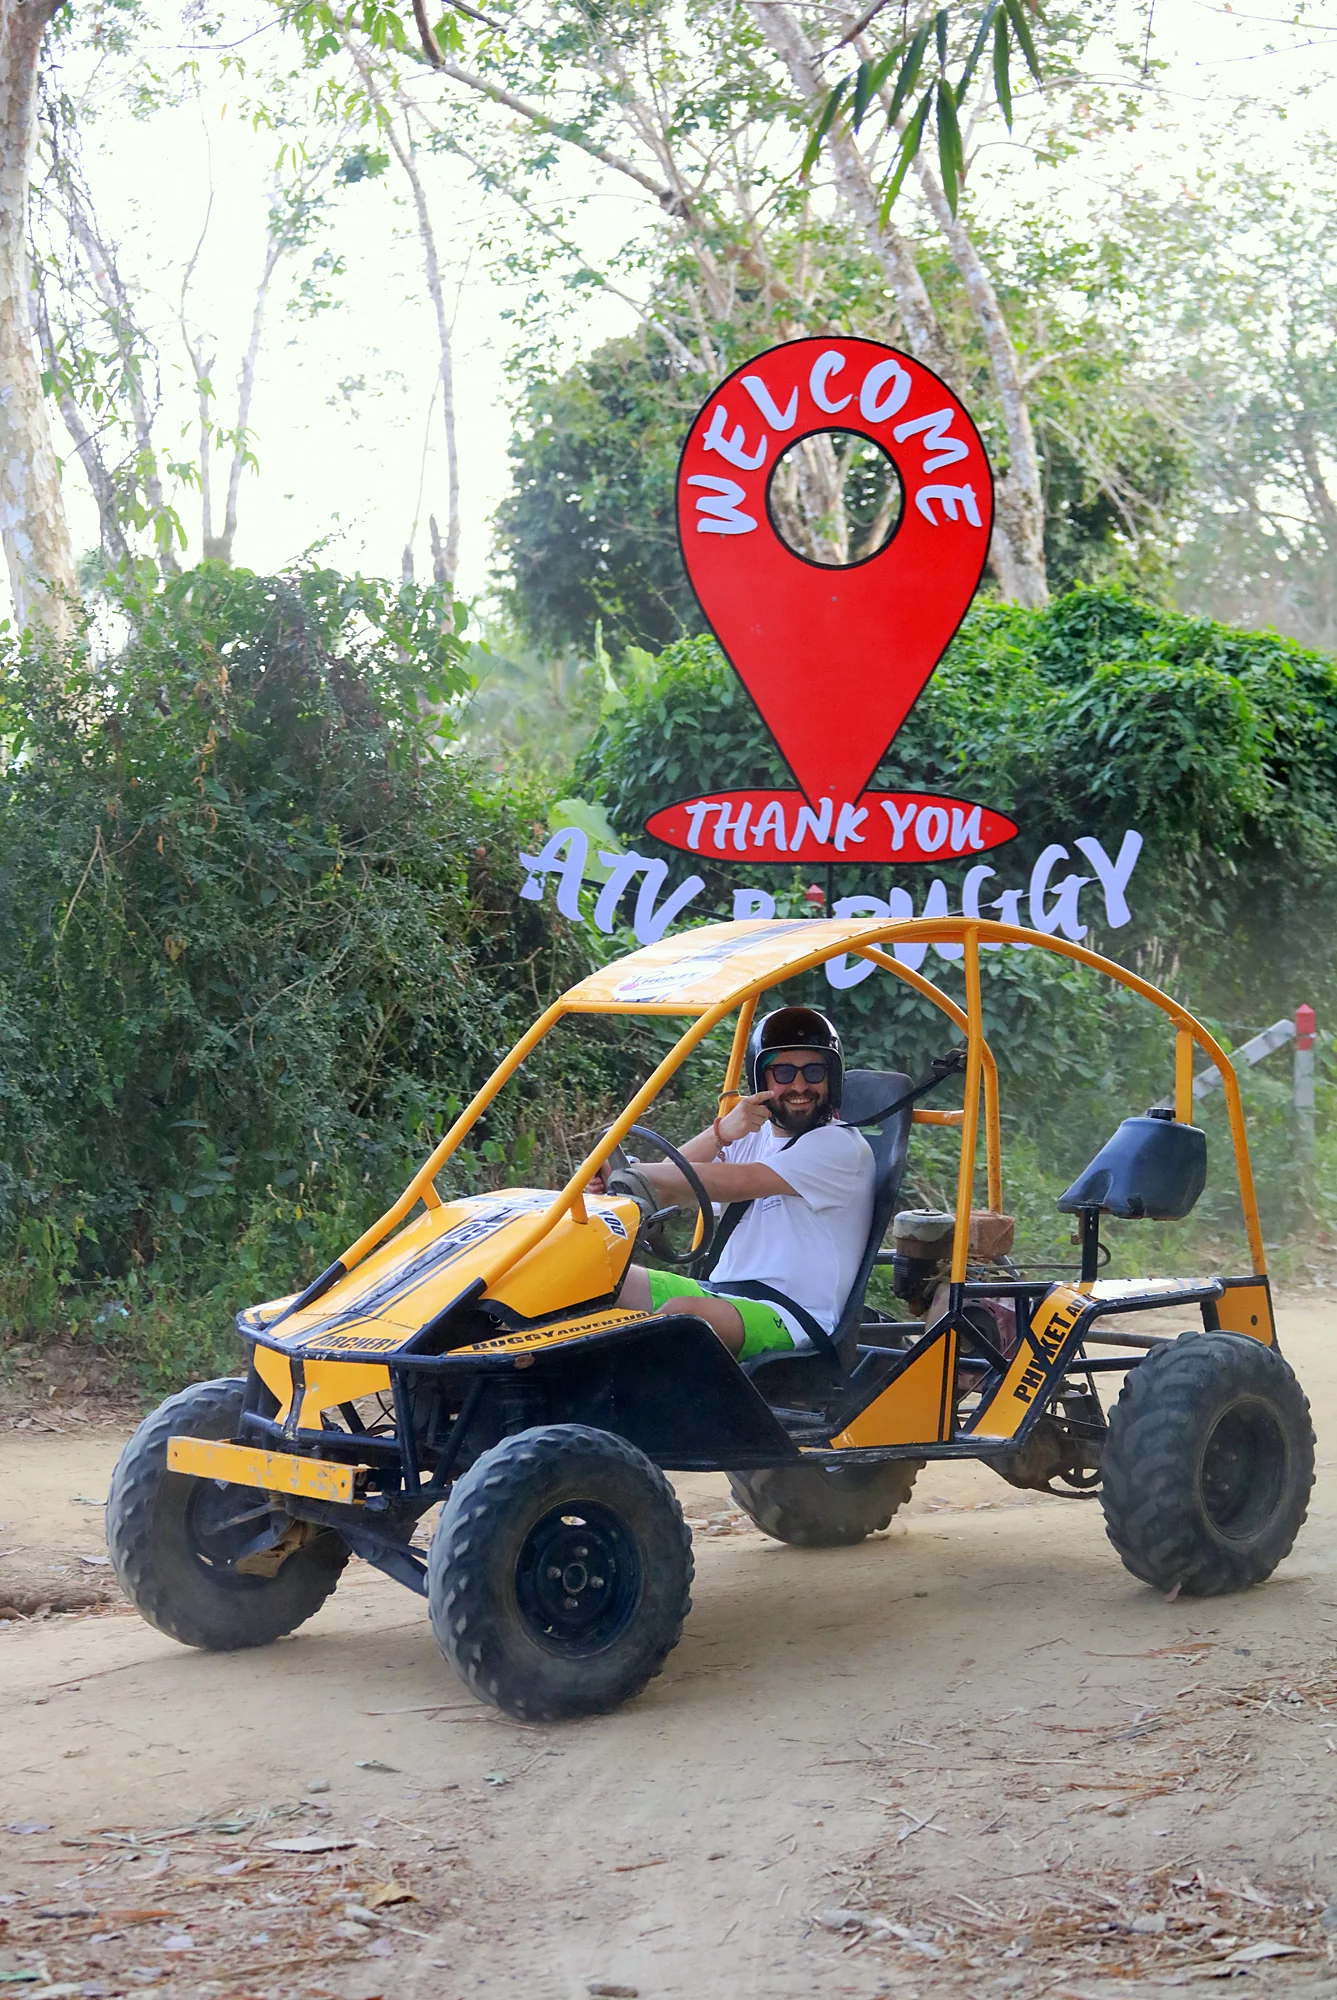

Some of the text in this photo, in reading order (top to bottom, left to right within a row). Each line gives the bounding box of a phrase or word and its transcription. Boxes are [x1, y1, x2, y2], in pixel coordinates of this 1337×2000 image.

[687, 350, 982, 535] WELCOME
[685, 797, 985, 852] THANK YOU
[519, 827, 1143, 989] ATV BUGGY
[442, 1222, 500, 1243] 05
[313, 1335, 403, 1351] ARCHERY
